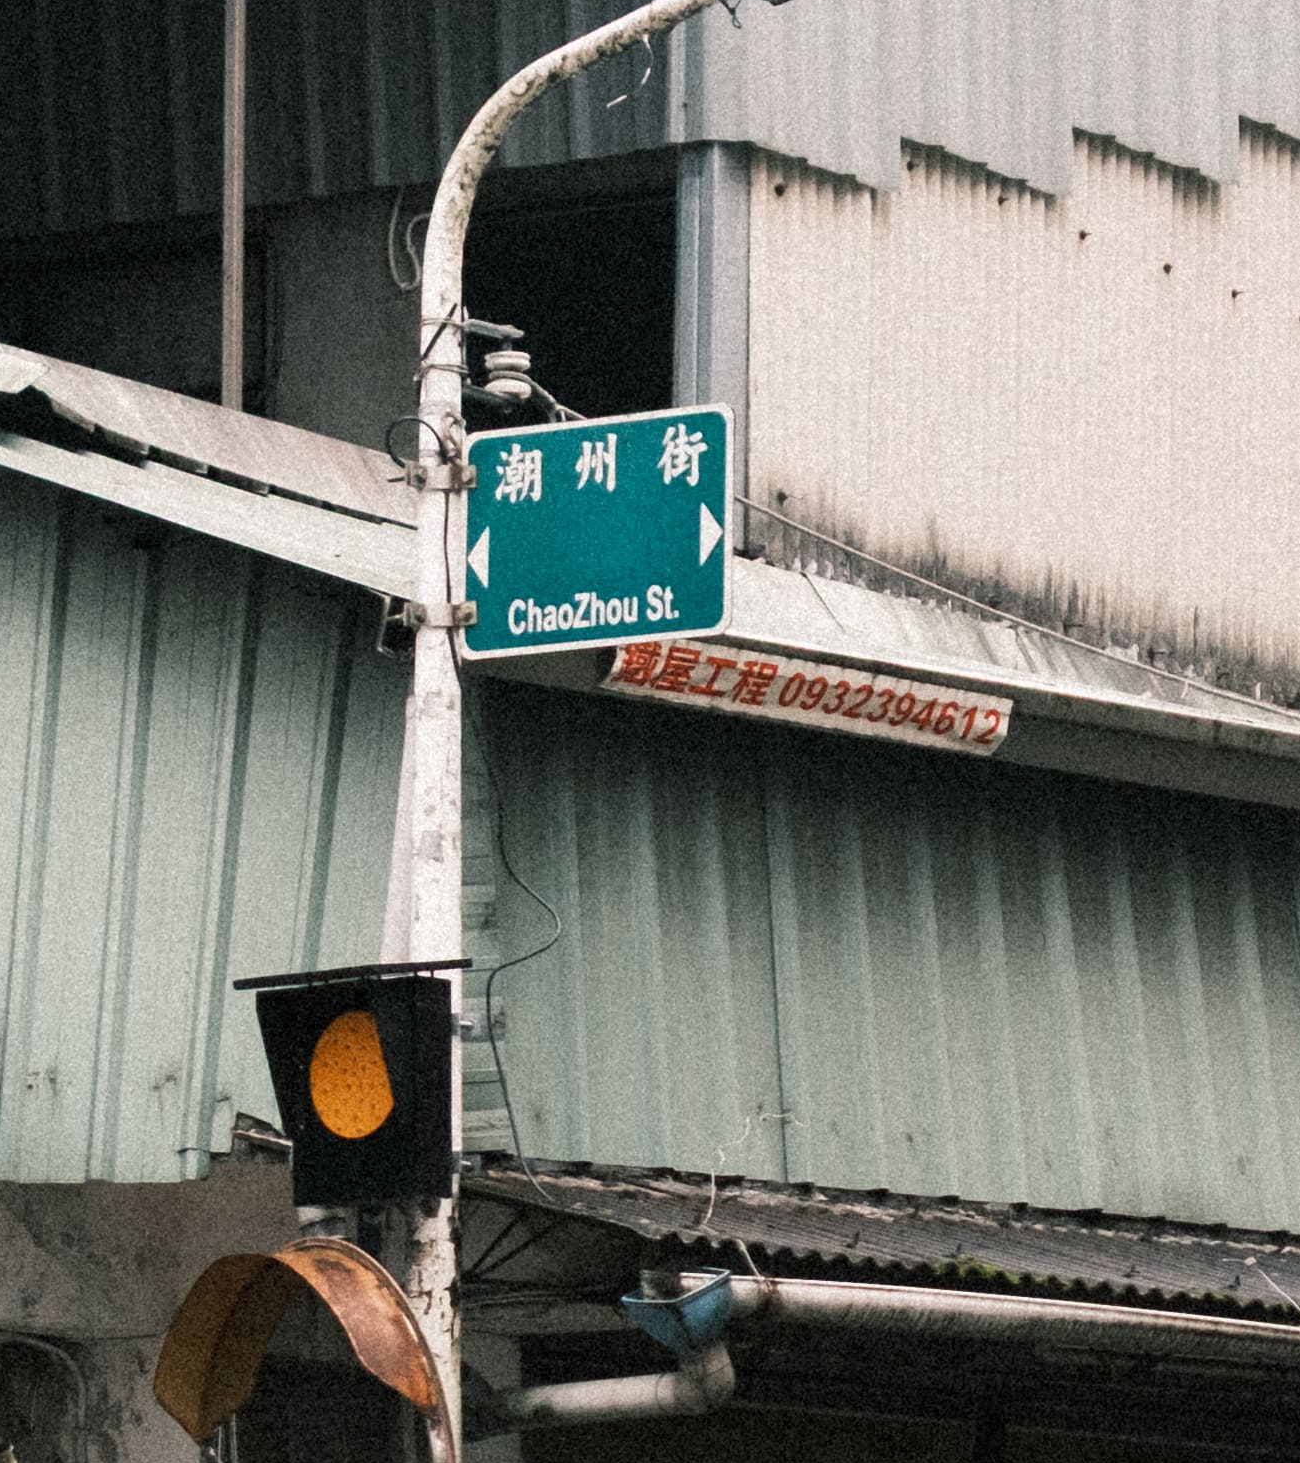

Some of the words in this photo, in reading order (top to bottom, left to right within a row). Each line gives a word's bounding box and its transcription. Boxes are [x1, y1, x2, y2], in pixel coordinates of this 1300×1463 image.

[495, 423, 708, 503] 潮州街
[508, 592, 638, 635] ChaoZhou
[646, 585, 680, 621] St.
[778, 673, 1001, 744] 0932394612
